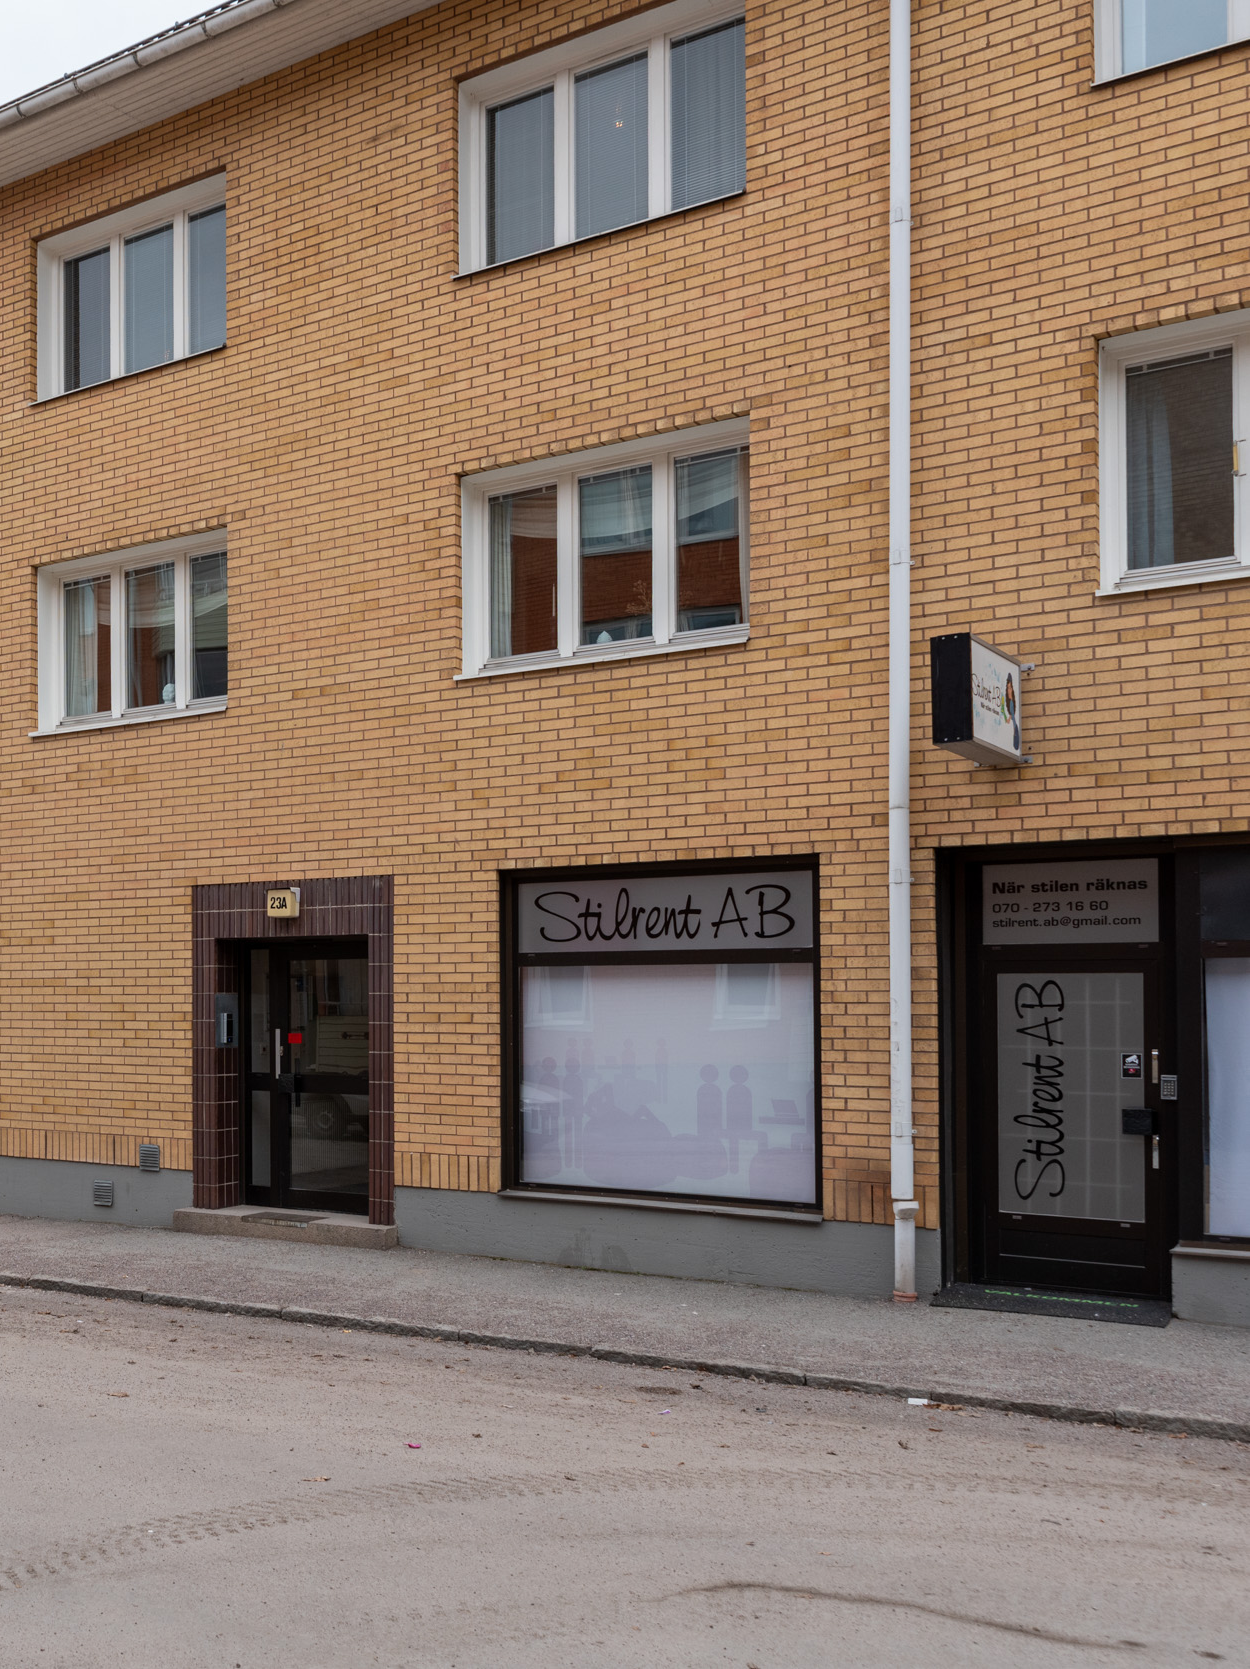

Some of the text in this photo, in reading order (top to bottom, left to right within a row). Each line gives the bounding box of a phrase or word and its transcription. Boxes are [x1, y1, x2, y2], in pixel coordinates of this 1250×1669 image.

[992, 878, 1148, 894] När stilen räknas
[270, 896, 287, 909] 23A
[992, 903, 1020, 913] 070
[1032, 902, 1060, 913] 273
[1066, 901, 1084, 912] 16
[1089, 900, 1109, 911] 60
[534, 884, 796, 942] Stilrent AB
[992, 915, 1142, 929] stilrent.ab@gmail.com
[1013, 980, 1065, 1200] Stilrent AB
